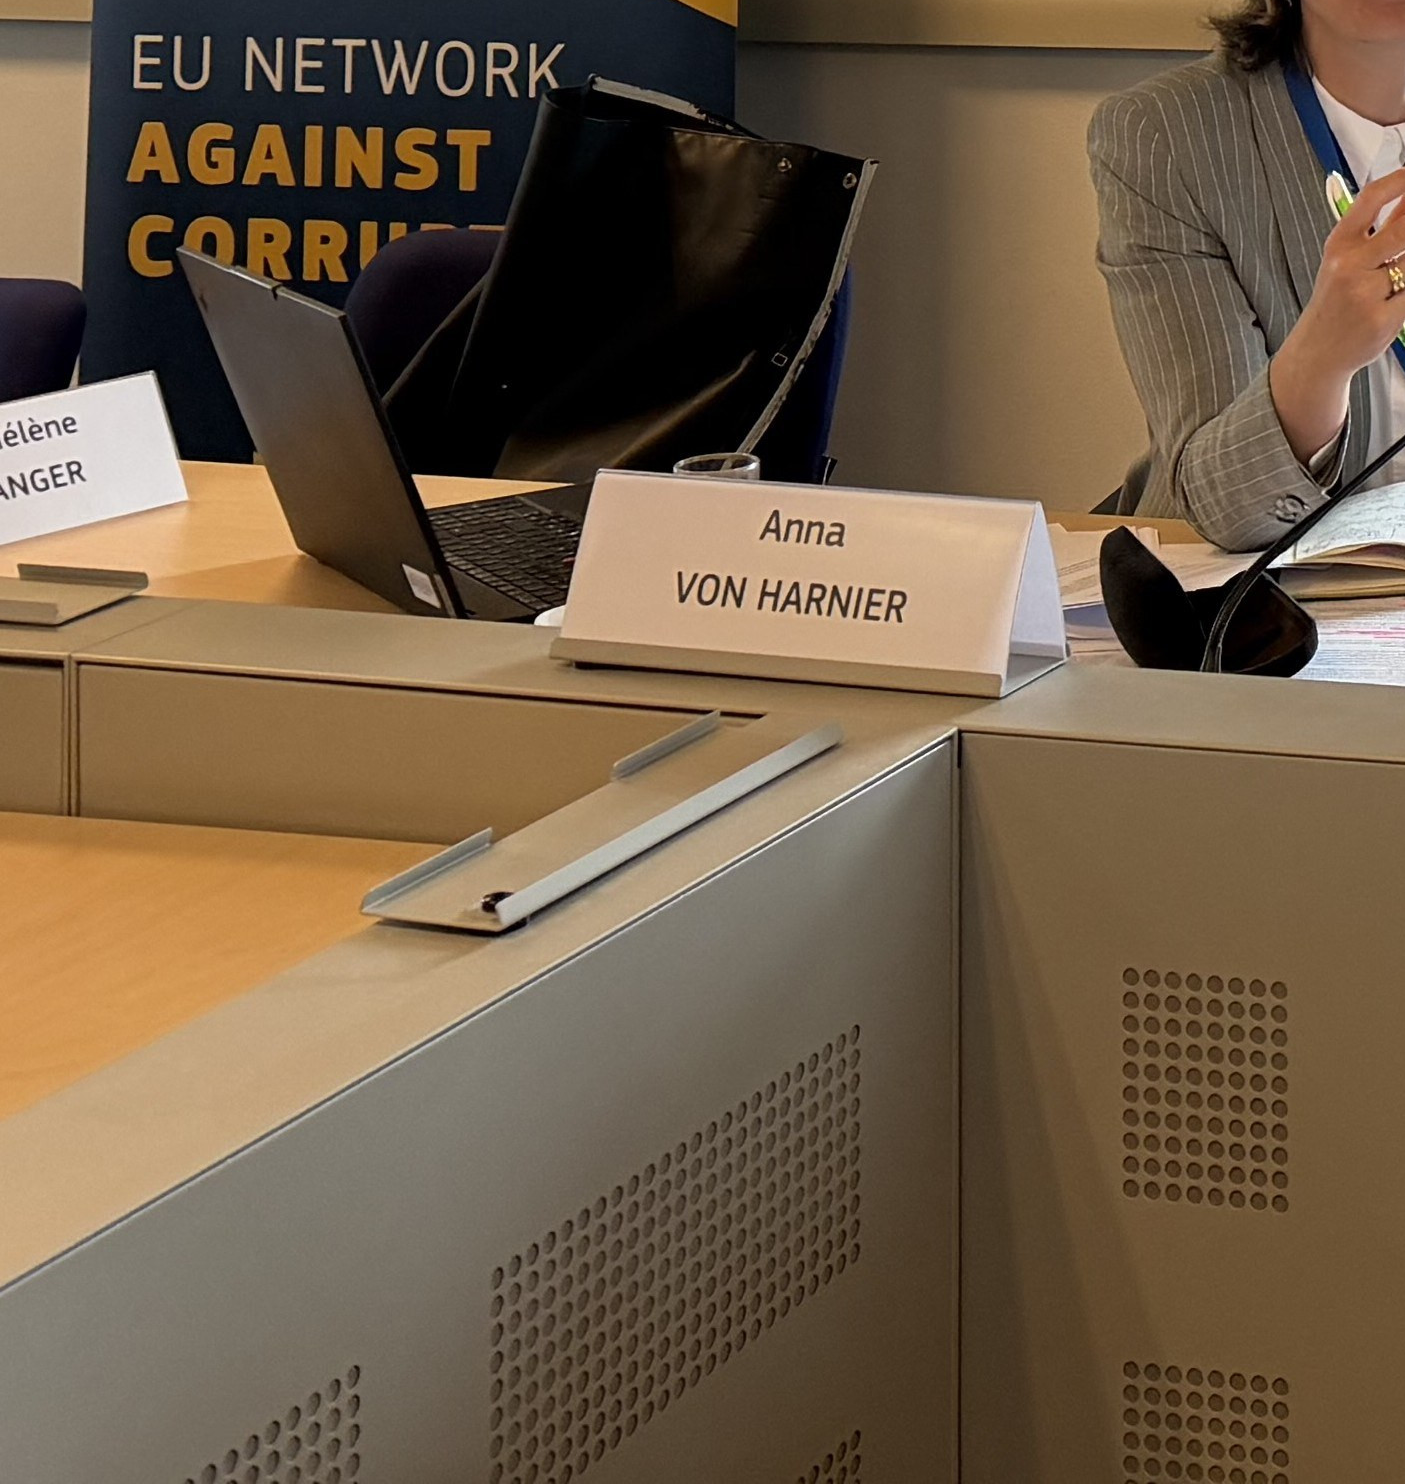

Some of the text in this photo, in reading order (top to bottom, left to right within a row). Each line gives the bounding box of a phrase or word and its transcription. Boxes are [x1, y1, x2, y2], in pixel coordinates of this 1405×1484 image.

[132, 34, 566, 99] EU NETWORK
[126, 121, 491, 192] AGAINST
[128, 214, 506, 283] CORRU
[0, 416, 78, 450] élène
[759, 509, 846, 548] Anna
[677, 571, 908, 624] VON HARNIER
